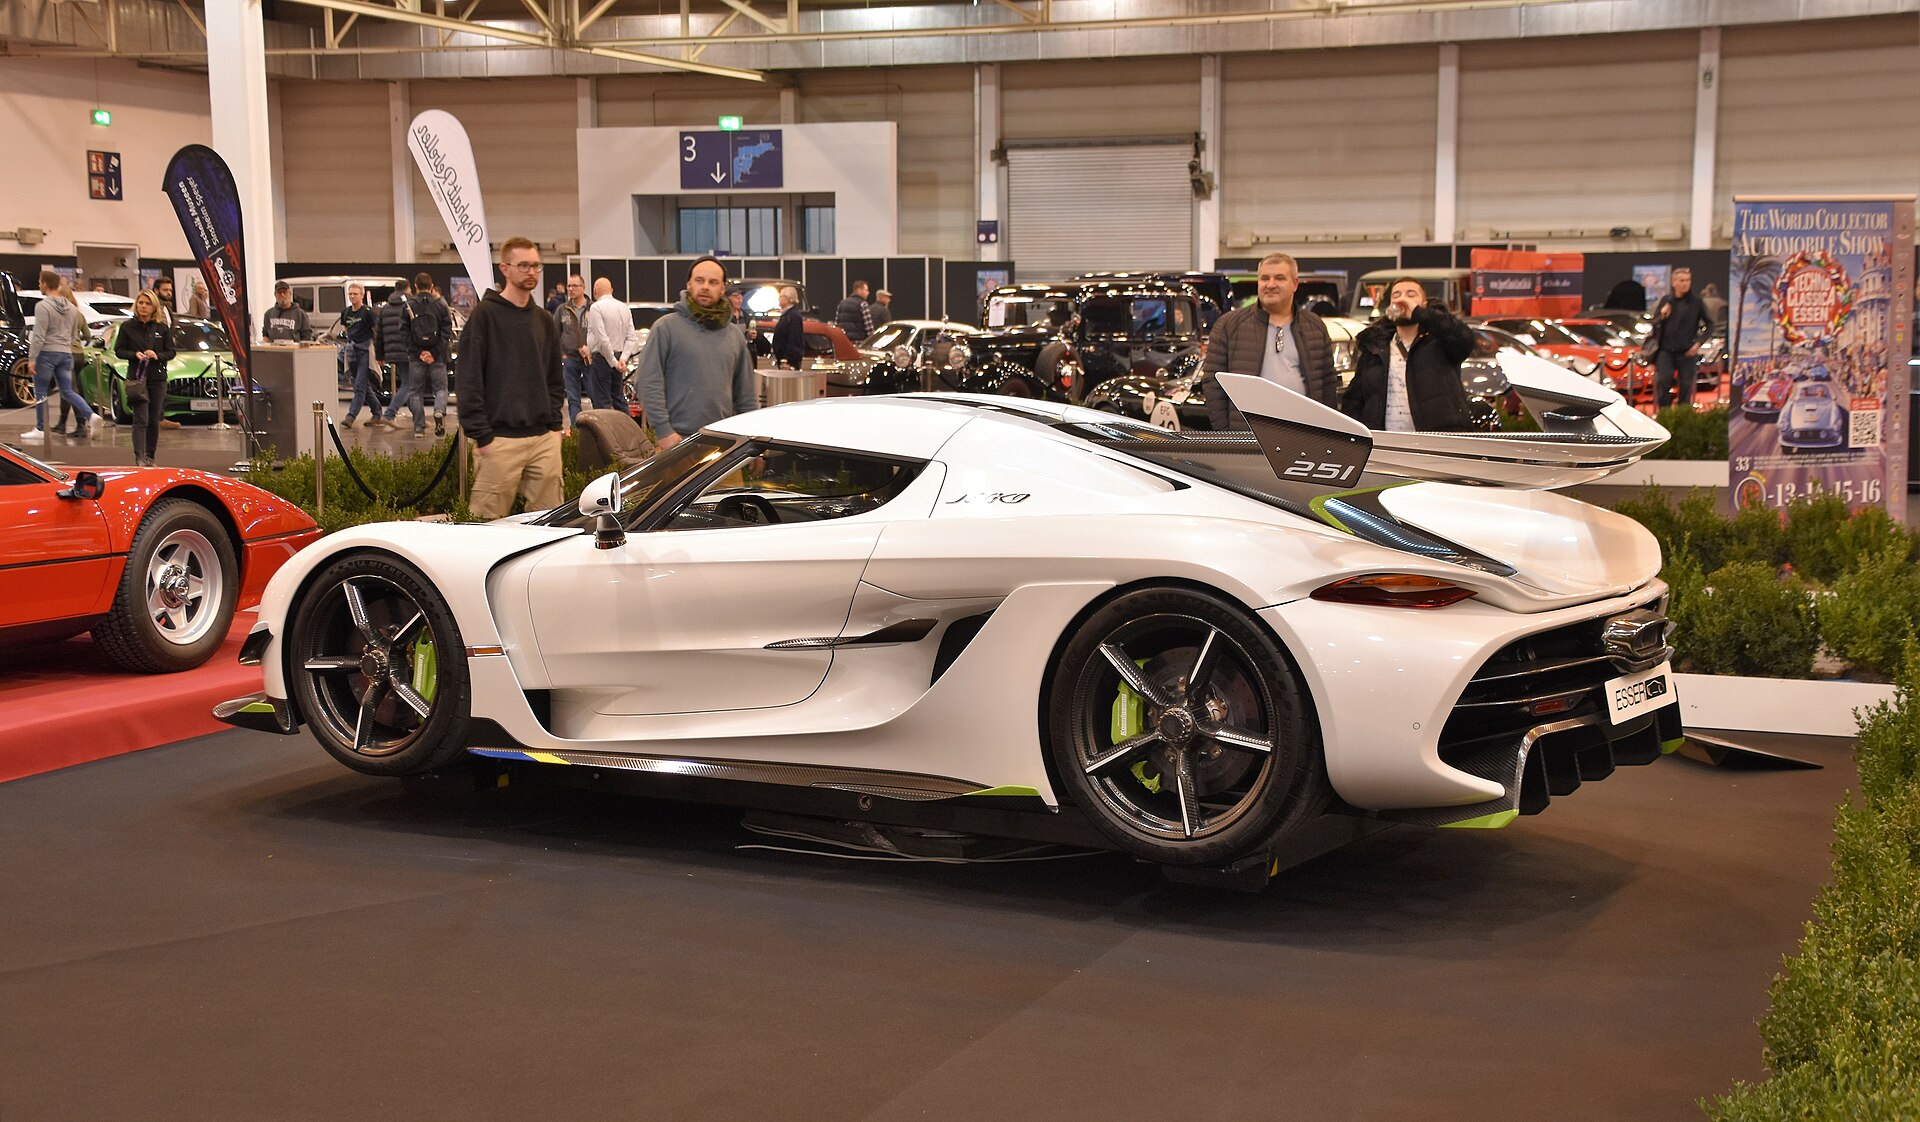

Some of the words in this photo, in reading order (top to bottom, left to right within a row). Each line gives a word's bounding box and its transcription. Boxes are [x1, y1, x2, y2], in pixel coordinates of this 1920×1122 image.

[684, 135, 697, 162] 3
[178, 181, 198, 217] Museen
[186, 176, 203, 206] Speyer
[200, 206, 219, 246] Sinsheim
[1741, 209, 1768, 231] THE
[1769, 208, 1814, 231] WORLD
[1815, 208, 1889, 231] COLLECTOR
[194, 218, 211, 251] Technik
[1839, 231, 1884, 256] SHOW
[1787, 286, 1836, 307] CLASSICA
[1792, 306, 1829, 323] ESSEN
[1283, 460, 1356, 481] 251
[368, 560, 423, 592] MICHELIN
[1615, 681, 1647, 711] ESSER
